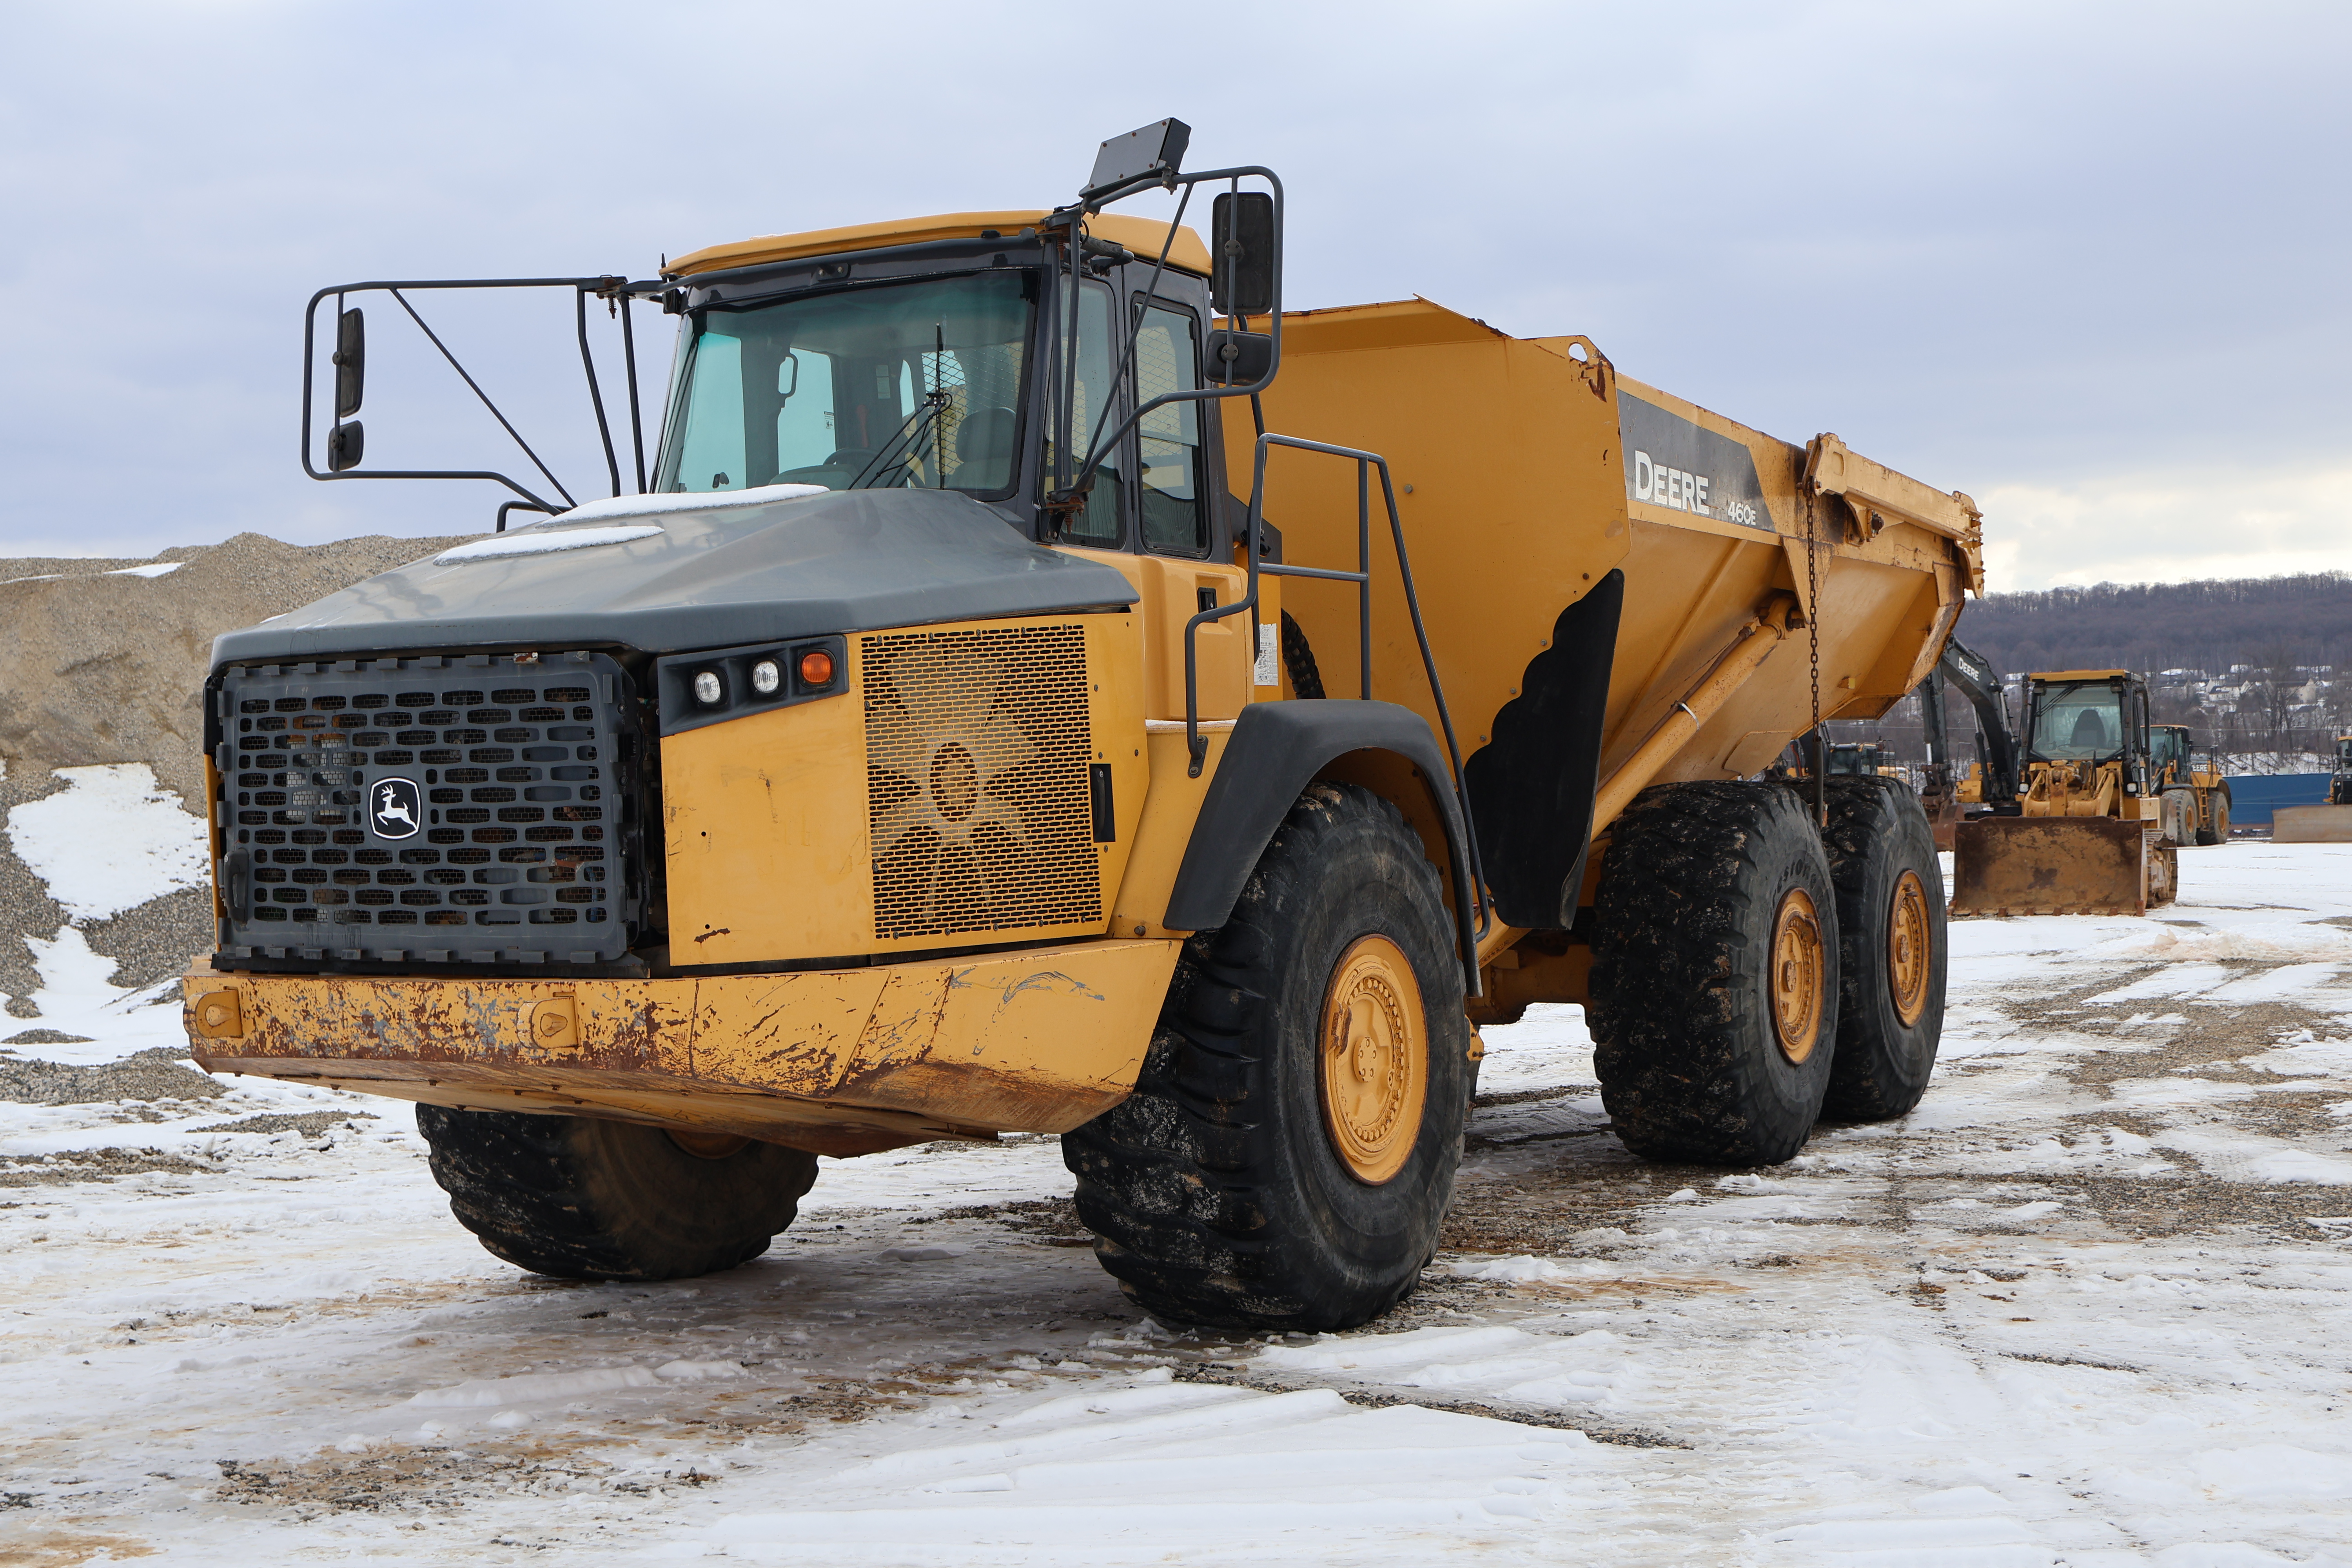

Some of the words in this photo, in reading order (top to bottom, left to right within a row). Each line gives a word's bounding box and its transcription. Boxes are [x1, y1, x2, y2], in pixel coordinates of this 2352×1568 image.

[1635, 450, 1709, 515] DEERE
[1728, 501, 1756, 526] 460E
[1958, 657, 1979, 682] DEERE
[2192, 764, 2208, 772] EERE
